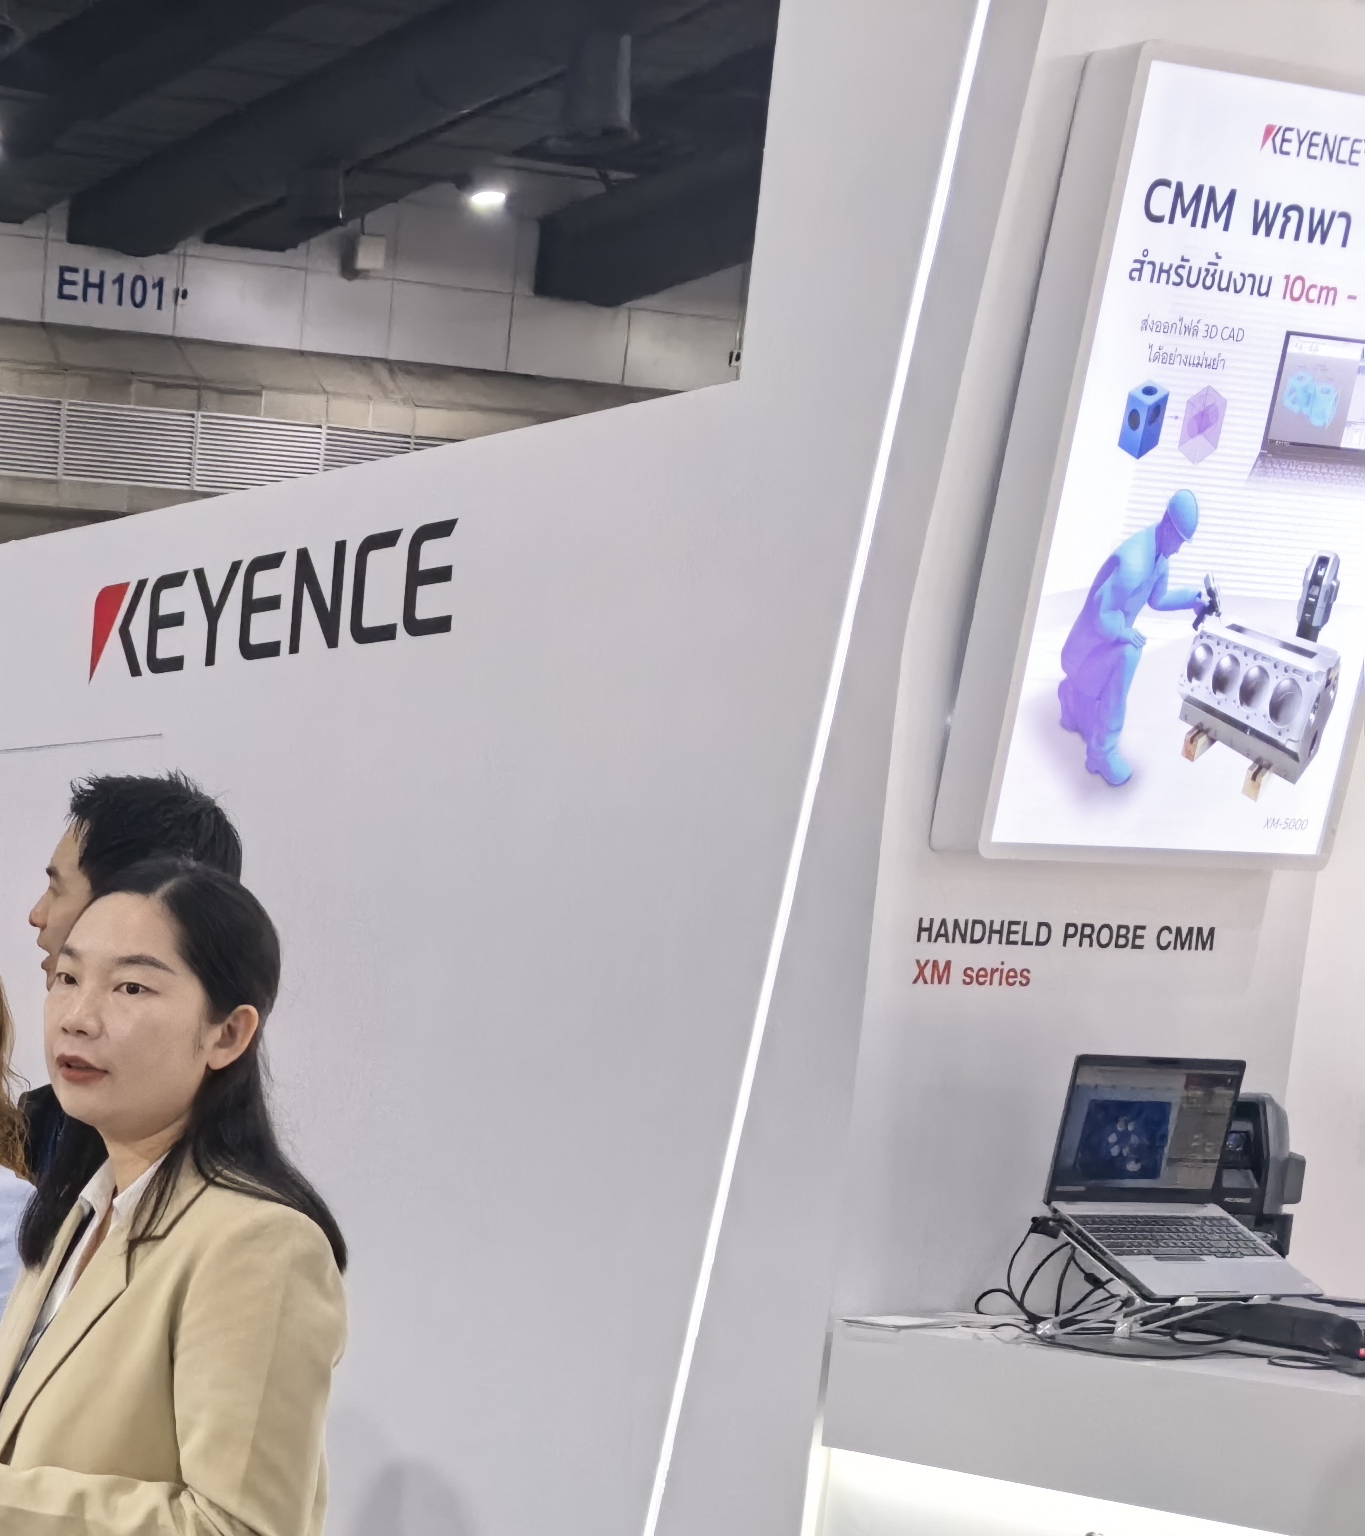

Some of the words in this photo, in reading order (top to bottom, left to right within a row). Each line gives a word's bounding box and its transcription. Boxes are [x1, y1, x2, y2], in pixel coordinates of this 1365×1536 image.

[1260, 123, 1363, 167] KEYENCE
[1144, 178, 1237, 232] CMM
[1252, 199, 1352, 248] พกพา
[57, 265, 165, 311] EH101
[1128, 248, 1273, 298] สำหรับชิ้นงาน
[1282, 274, 1338, 306] 10cm
[1202, 323, 1218, 339] 3D
[1221, 326, 1245, 342] CAD
[88, 517, 459, 686] KEYENCE
[916, 917, 1053, 948] HANDHELD
[1062, 922, 1147, 950] PROBE
[1156, 925, 1216, 952] CMM
[912, 959, 952, 986] XM
[962, 961, 1031, 987] series
